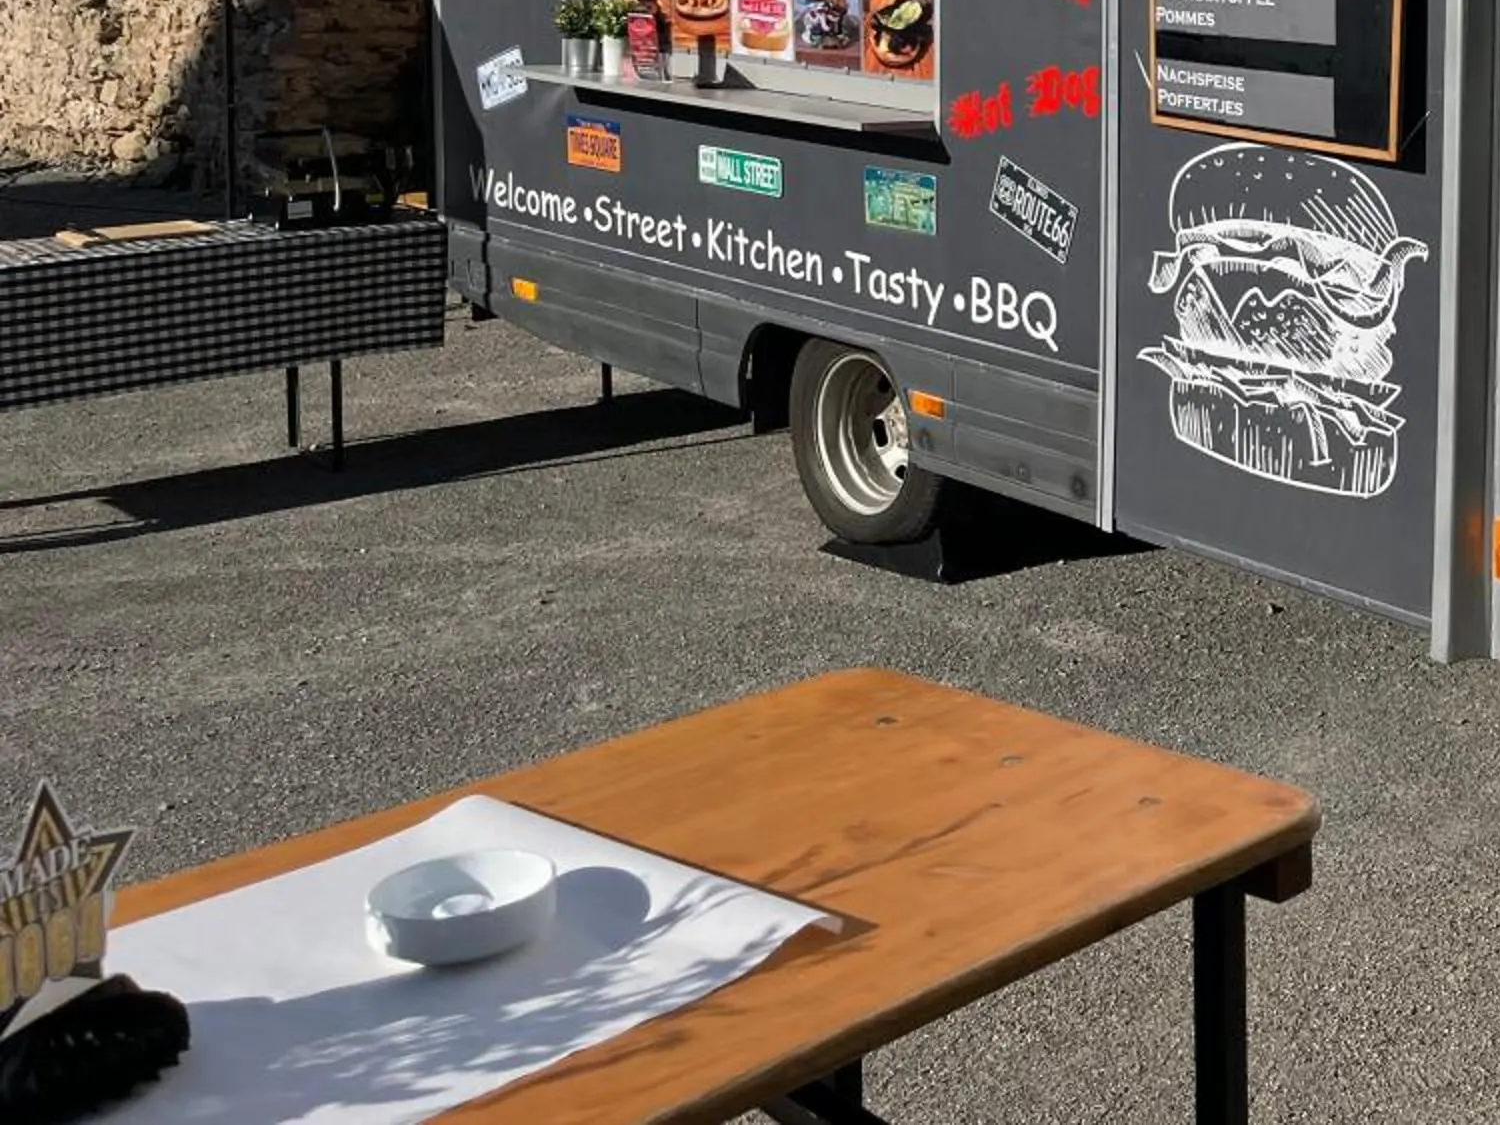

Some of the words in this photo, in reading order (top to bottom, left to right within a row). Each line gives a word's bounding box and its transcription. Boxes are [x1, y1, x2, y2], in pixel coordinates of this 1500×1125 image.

[1156, 6, 1216, 27] POMMES
[1157, 64, 1245, 92] NACHSPEISE
[946, 80, 1014, 140] Hot
[1026, 64, 1102, 118] Dog
[1157, 89, 1244, 116] POFFERTJES
[744, 160, 779, 188] STREET
[468, 162, 578, 224] Welcome
[594, 195, 687, 252] Street
[708, 218, 823, 286] Kitchen
[845, 250, 944, 325] Tasty
[971, 276, 1059, 352] BBQ
